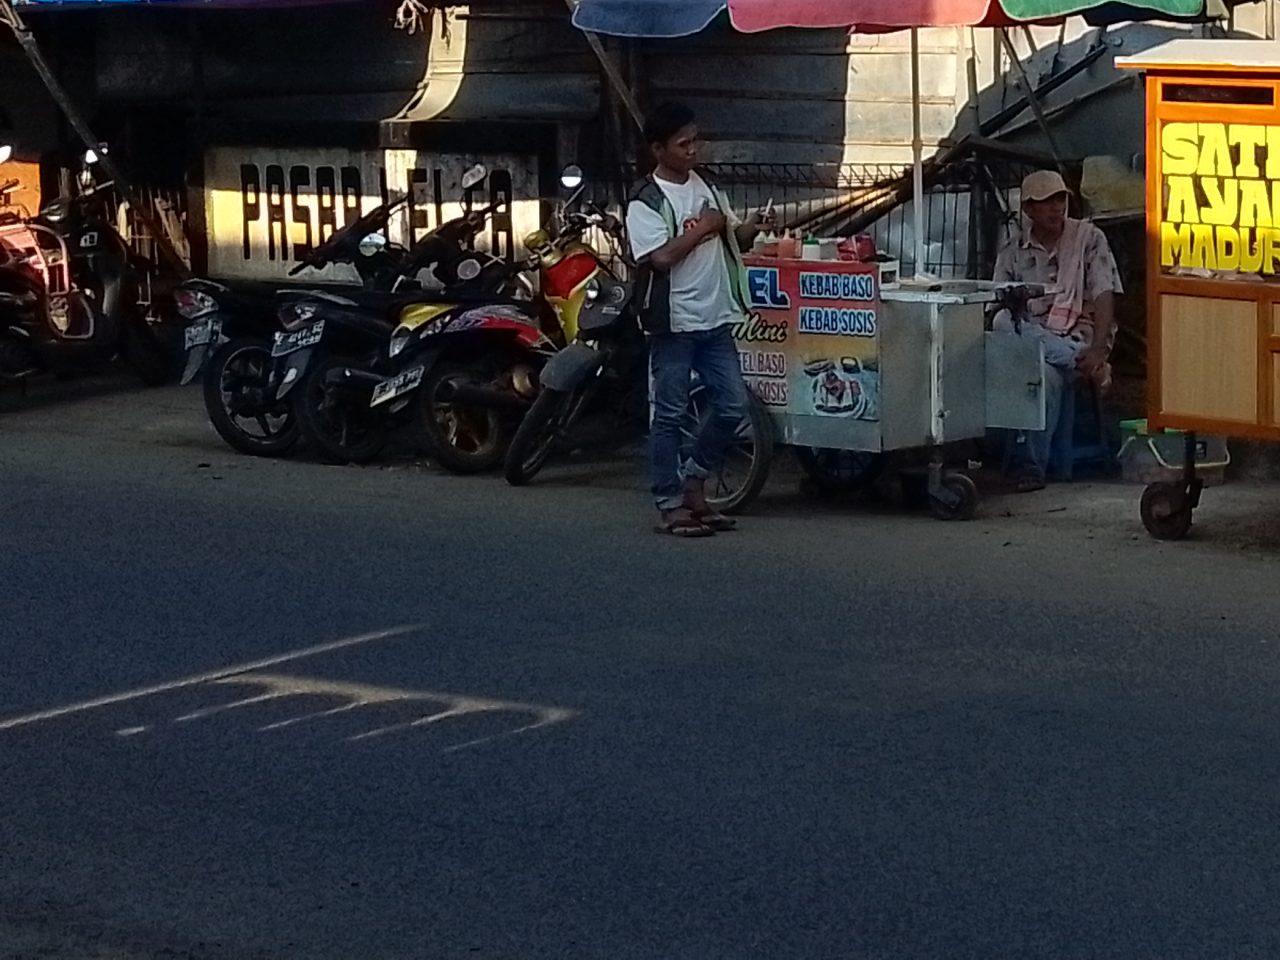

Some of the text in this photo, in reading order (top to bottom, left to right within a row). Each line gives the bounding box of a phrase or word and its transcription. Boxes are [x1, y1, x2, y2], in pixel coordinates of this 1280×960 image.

[800, 273, 874, 299] KEBAB BASO
[731, 312, 787, 342] Mini
[799, 308, 875, 334] KEBAB SOSIS
[757, 352, 785, 374] BASO
[757, 380, 787, 402] SOSIS
